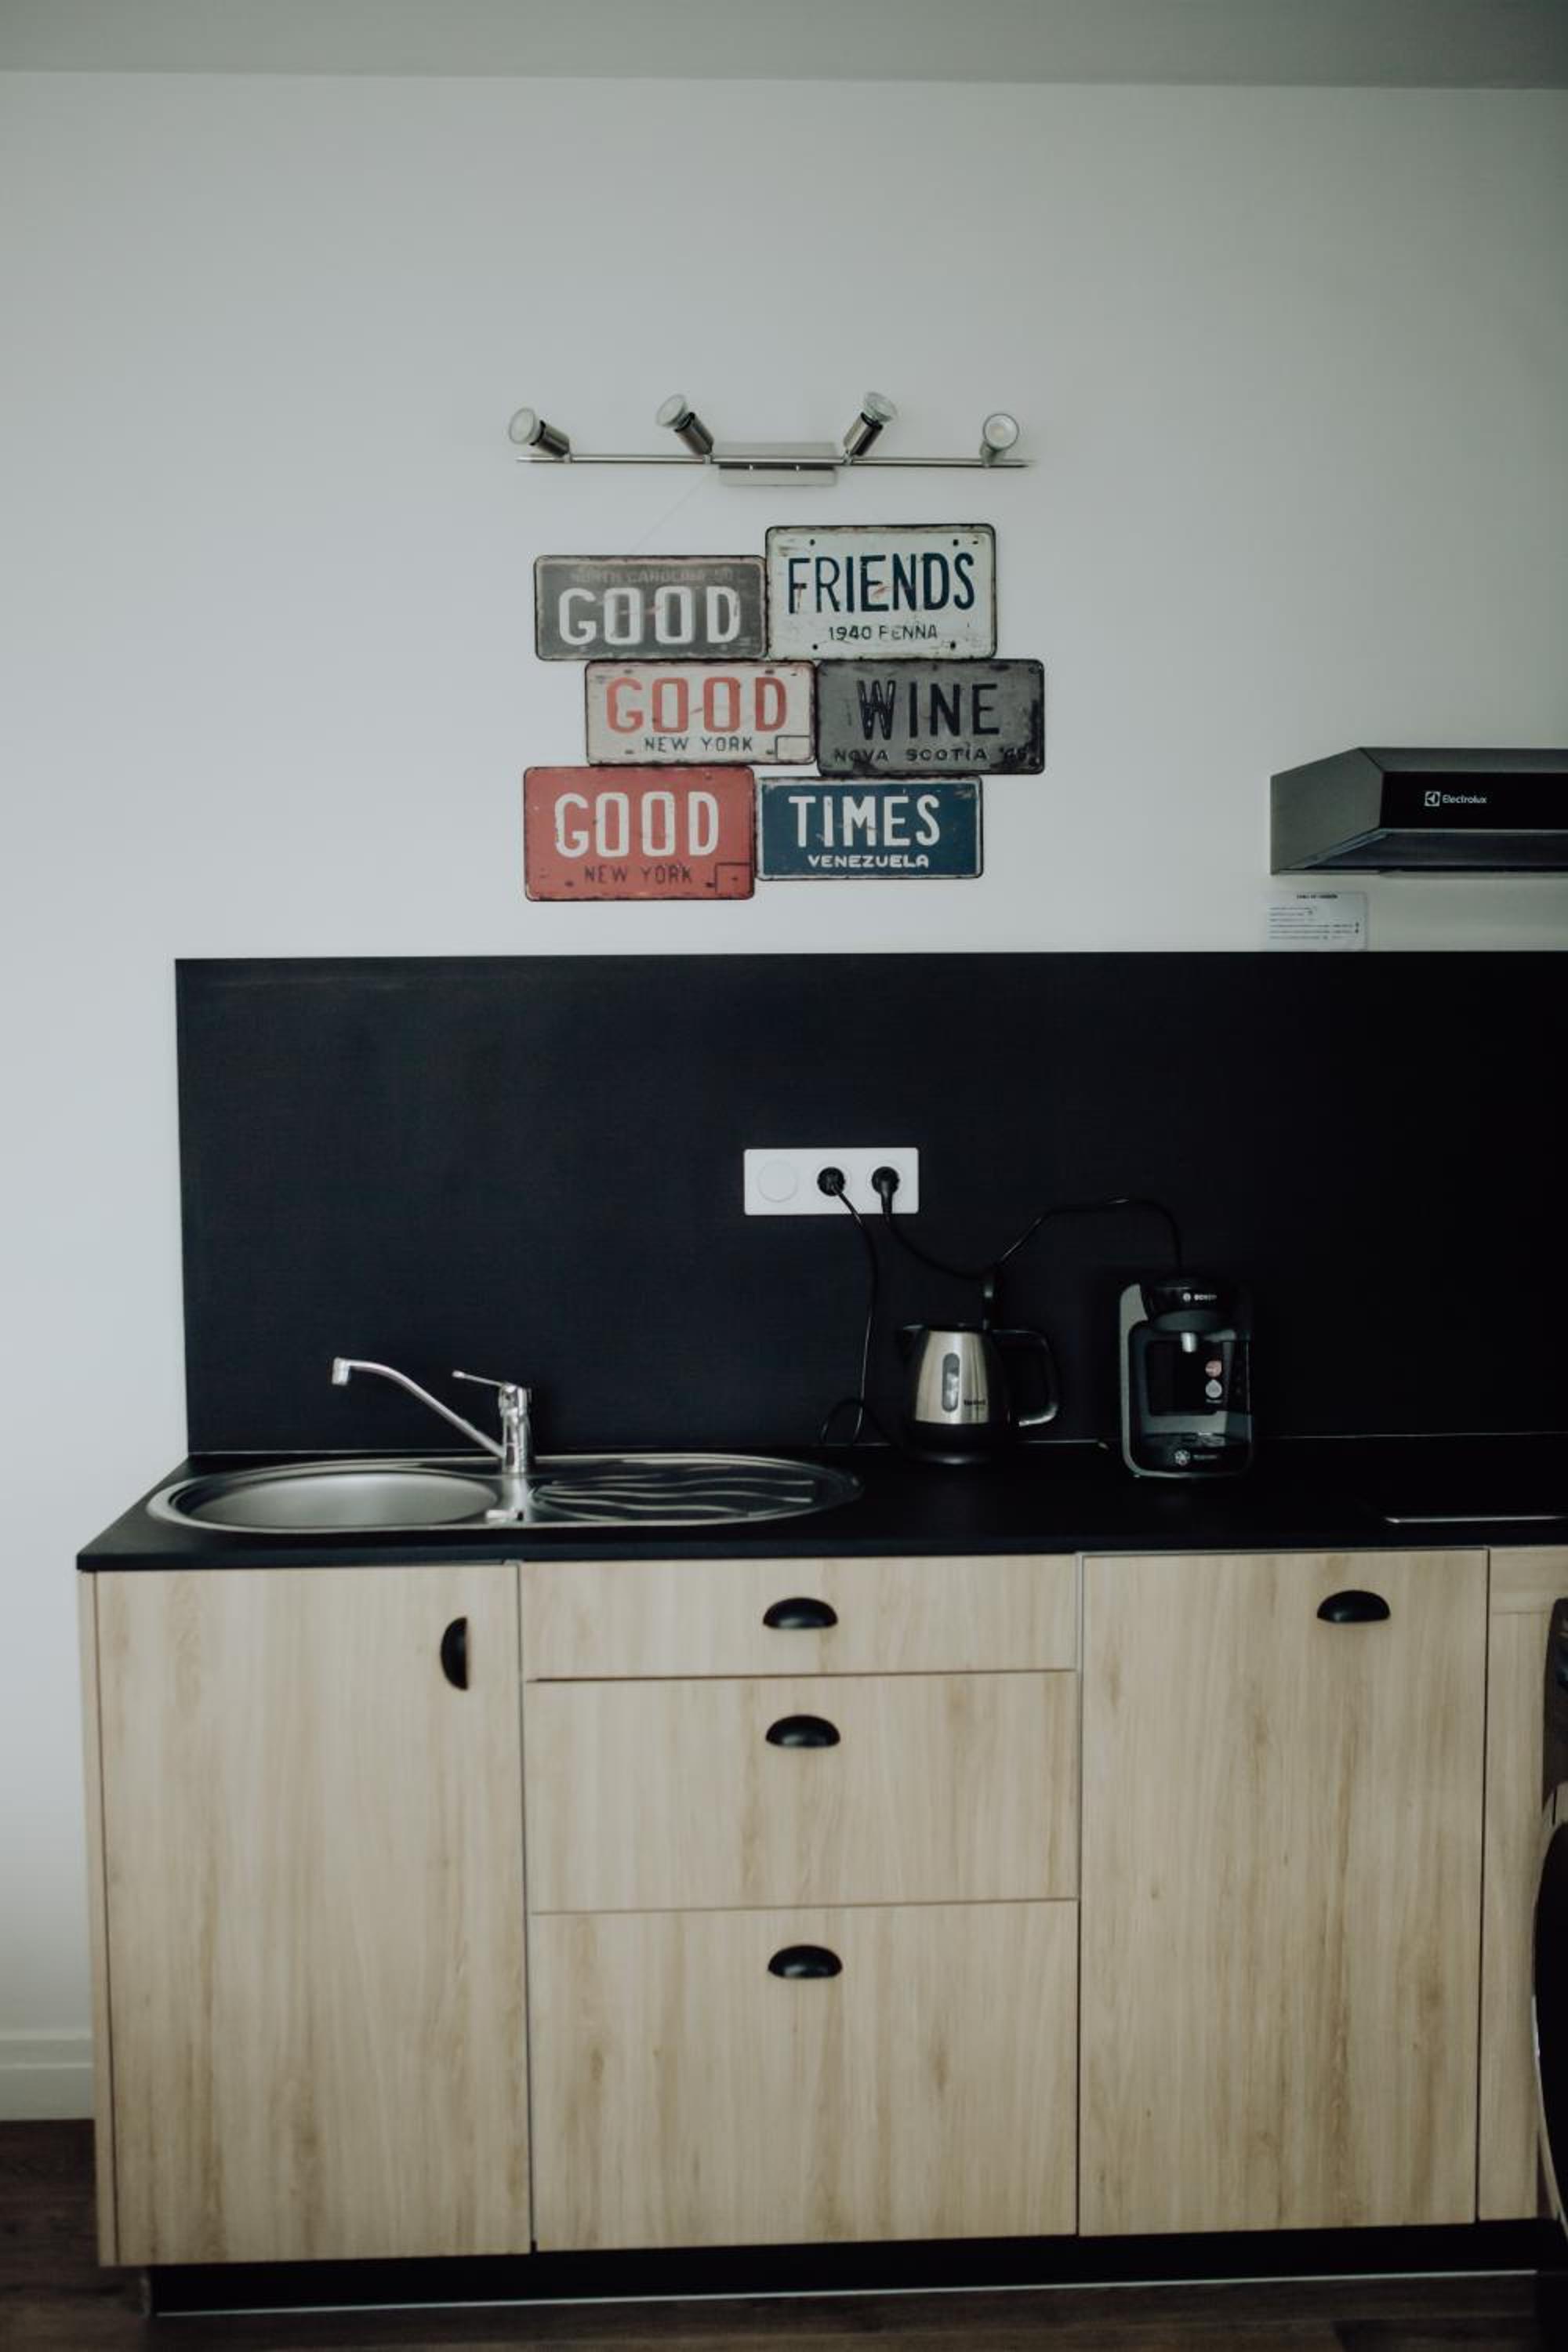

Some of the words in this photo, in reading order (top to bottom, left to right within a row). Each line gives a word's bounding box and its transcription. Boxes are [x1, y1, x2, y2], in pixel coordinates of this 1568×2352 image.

[787, 552, 975, 615] FRIENDS
[558, 586, 741, 646] GOOD
[829, 626, 872, 641] 1940
[605, 677, 788, 734] GOOD
[856, 679, 1000, 741] WINE
[644, 736, 690, 753] NEW
[701, 735, 753, 753] YORK
[834, 747, 890, 763] NOVA
[906, 743, 989, 762] SCOTIA
[1443, 793, 1487, 804] Electrolux
[554, 790, 720, 858] GOOD
[788, 793, 942, 848] TIMES
[584, 865, 627, 884] NEW
[639, 864, 693, 884] YORK
[807, 853, 931, 869] VENEZUELA
